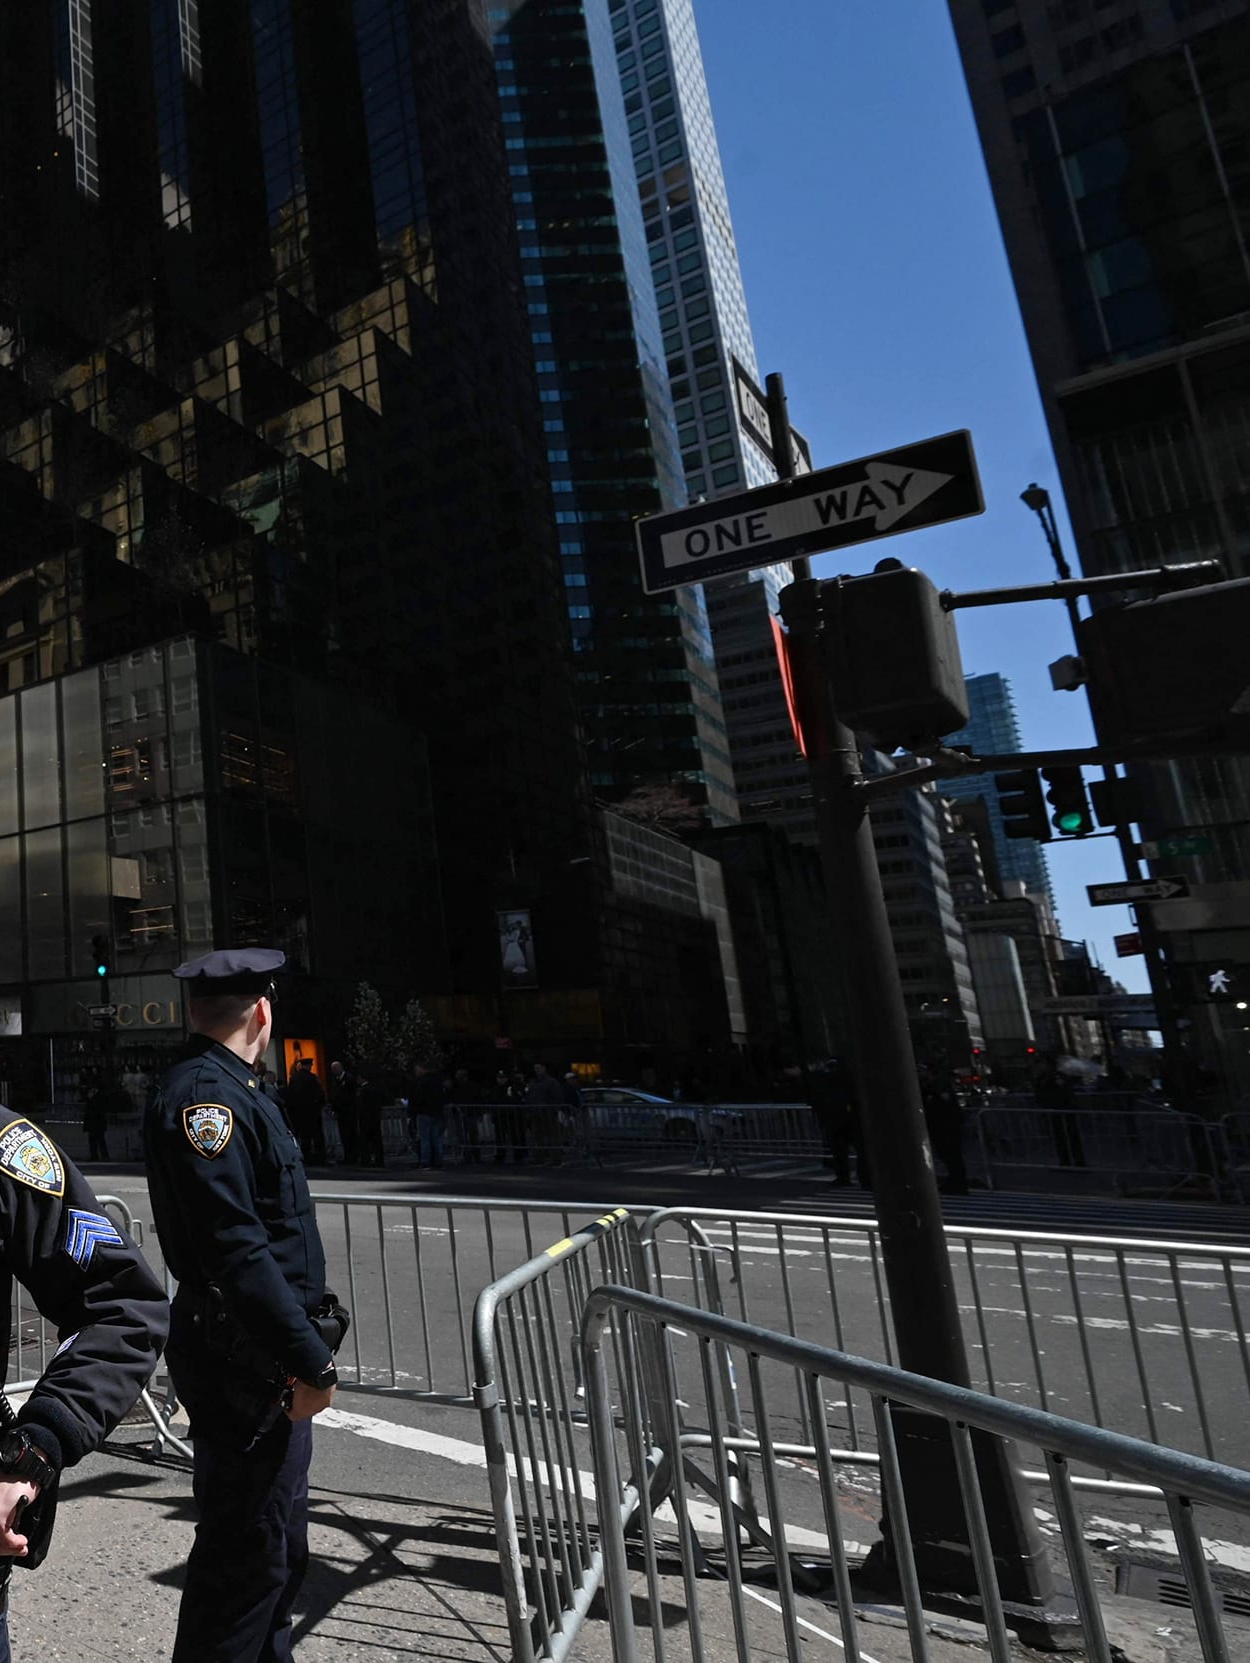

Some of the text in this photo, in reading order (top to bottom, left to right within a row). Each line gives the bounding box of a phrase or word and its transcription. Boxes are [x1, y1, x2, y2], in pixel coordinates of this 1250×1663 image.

[685, 472, 915, 557] ONE WAY
[188, 1113, 228, 1122] DEPARTMENT
[0, 1126, 23, 1151] POLICE
[0, 1129, 37, 1167] DEPARTMENT
[15, 1170, 51, 1189] CITY OF
